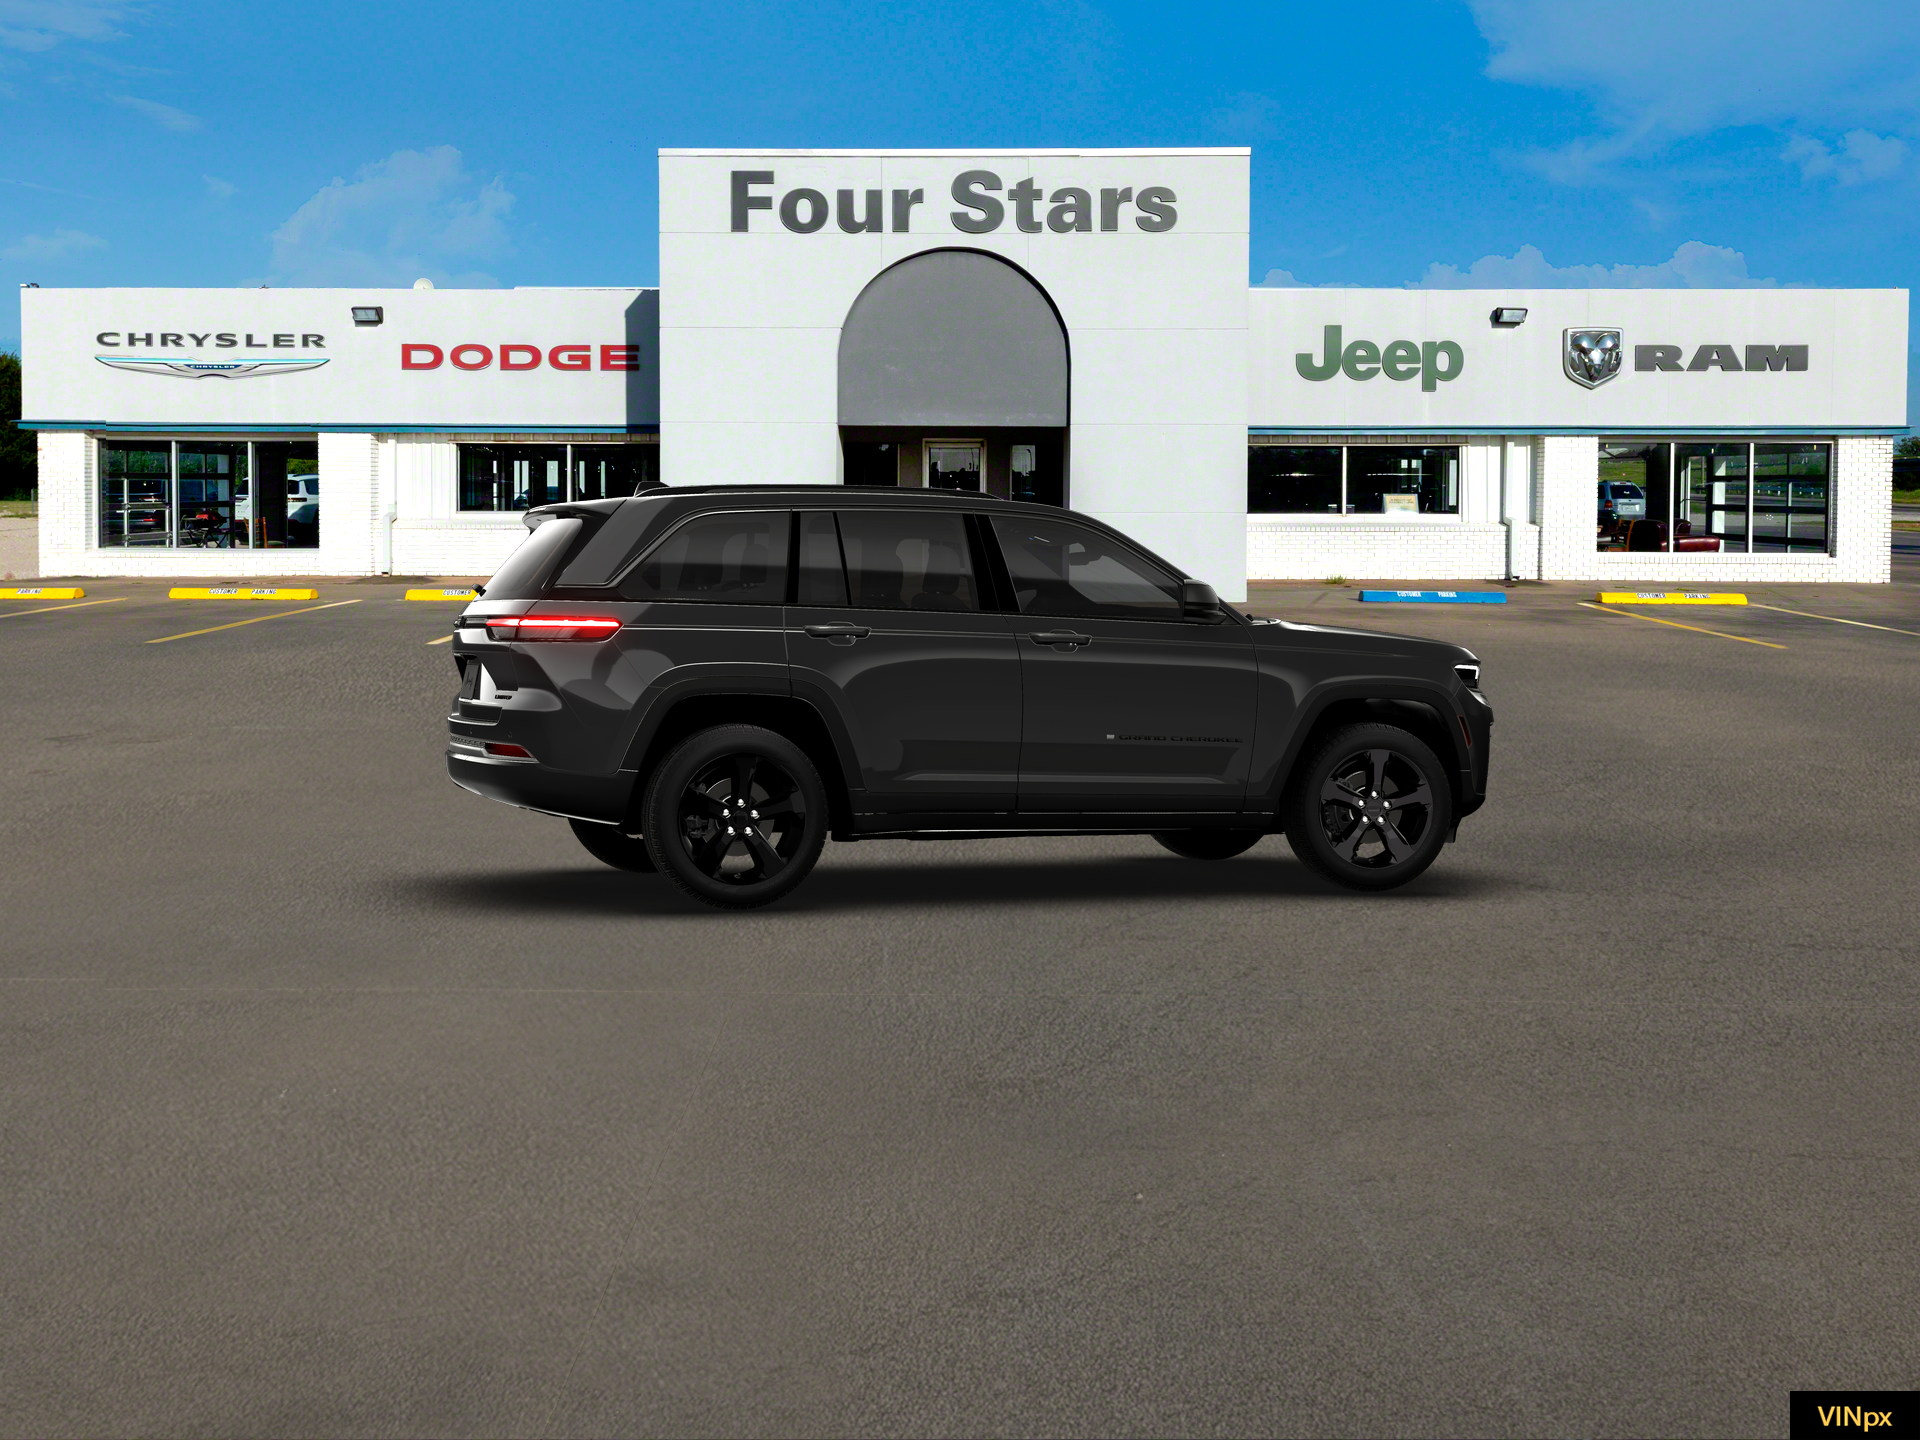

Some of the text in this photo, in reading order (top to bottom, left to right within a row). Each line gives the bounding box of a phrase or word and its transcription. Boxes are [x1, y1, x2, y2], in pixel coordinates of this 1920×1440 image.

[730, 169, 1178, 233] Four Stars
[96, 332, 327, 348] CHRYSLER
[401, 343, 640, 371] DODGE
[1295, 325, 1464, 393] Jeep
[1634, 344, 1809, 372] RAM
[1170, 735, 1244, 743] CHEROKEE
